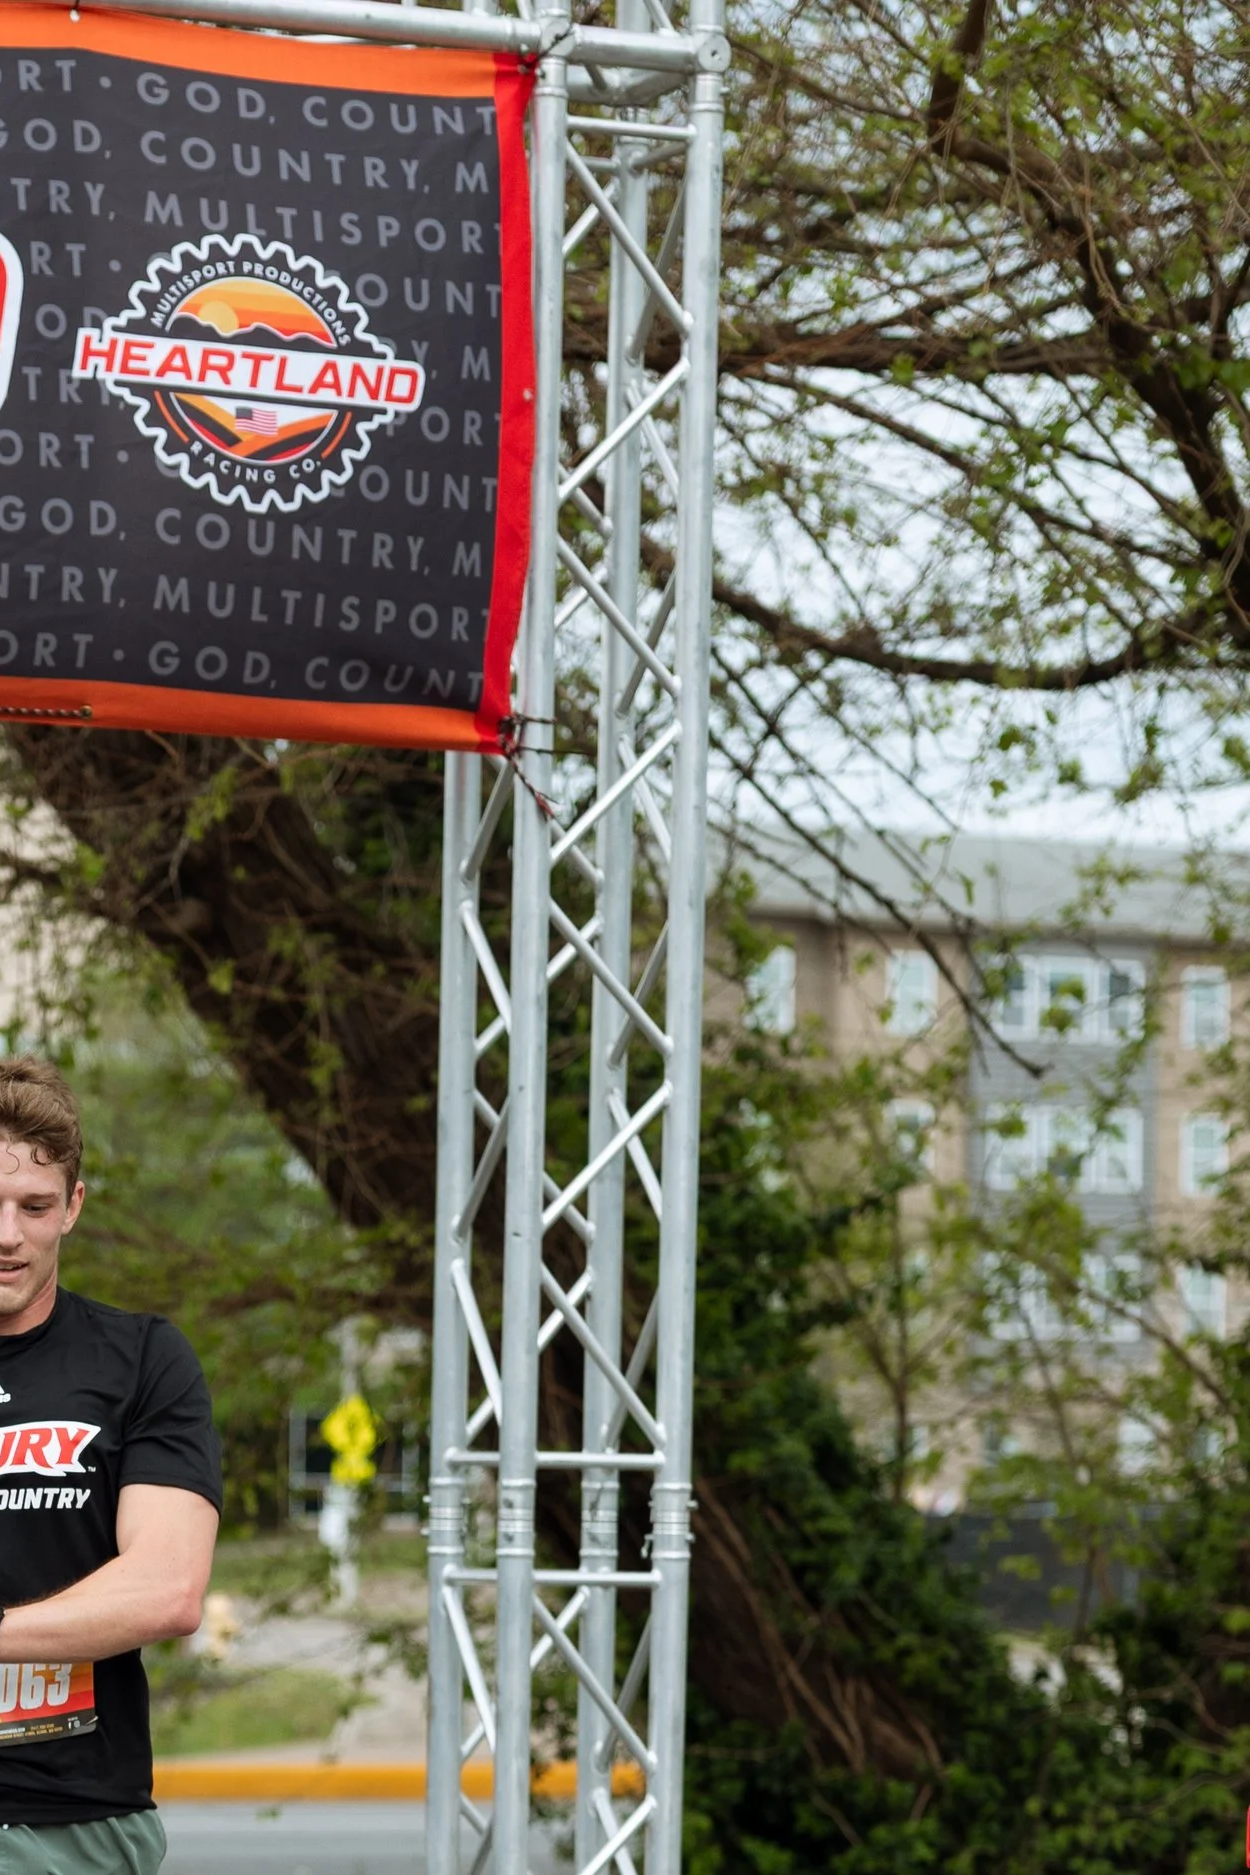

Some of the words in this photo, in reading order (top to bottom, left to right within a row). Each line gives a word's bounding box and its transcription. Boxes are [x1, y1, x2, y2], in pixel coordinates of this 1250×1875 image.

[136, 71, 276, 125] GOD,
[301, 95, 496, 136] COUNT
[140, 130, 430, 194] COUNTRY,
[150, 260, 235, 329] MULTISPORT
[242, 260, 351, 347] PRODUCTIONS
[323, 270, 502, 318] OUNT
[77, 333, 420, 406] HEARTLAND
[190, 440, 277, 483] RACING
[330, 465, 498, 512] OUNT
[155, 507, 431, 576] COUNTRY,
[148, 640, 277, 689] GOD,
[304, 656, 484, 704] COUNT
